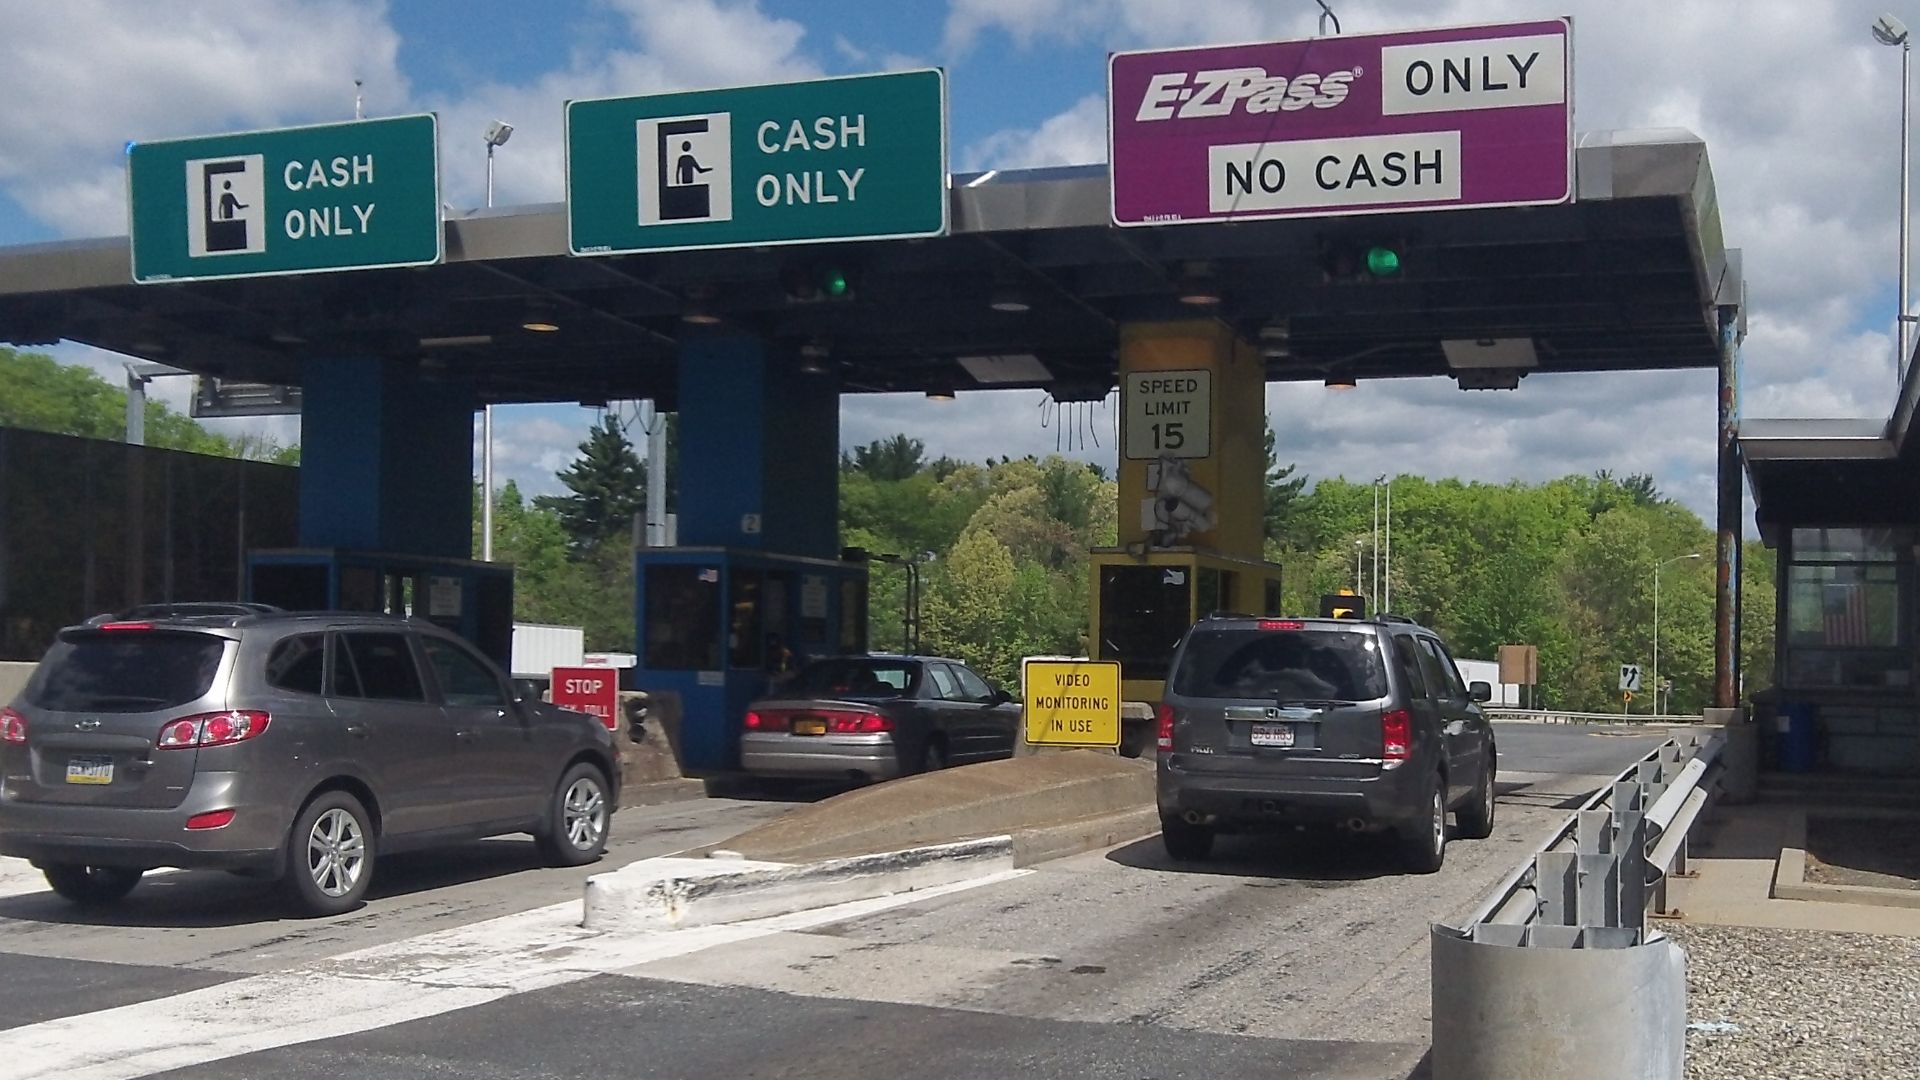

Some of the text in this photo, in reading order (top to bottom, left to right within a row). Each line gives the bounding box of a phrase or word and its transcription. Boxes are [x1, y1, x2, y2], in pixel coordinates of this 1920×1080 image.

[1405, 52, 1540, 96] ONLY
[757, 114, 866, 154] CASH
[284, 154, 374, 191] CASH
[1226, 149, 1443, 196] NO CASH
[756, 168, 865, 207] ONLY
[285, 203, 375, 240] ONLY
[1139, 379, 1198, 394] SPEED
[1145, 401, 1191, 416] LIMIT
[1151, 422, 1185, 450] 15
[565, 678, 603, 695] STOP
[1055, 674, 1090, 687] VIDEO
[1036, 696, 1109, 710] MONITORING
[1051, 719, 1093, 732] IN USE
